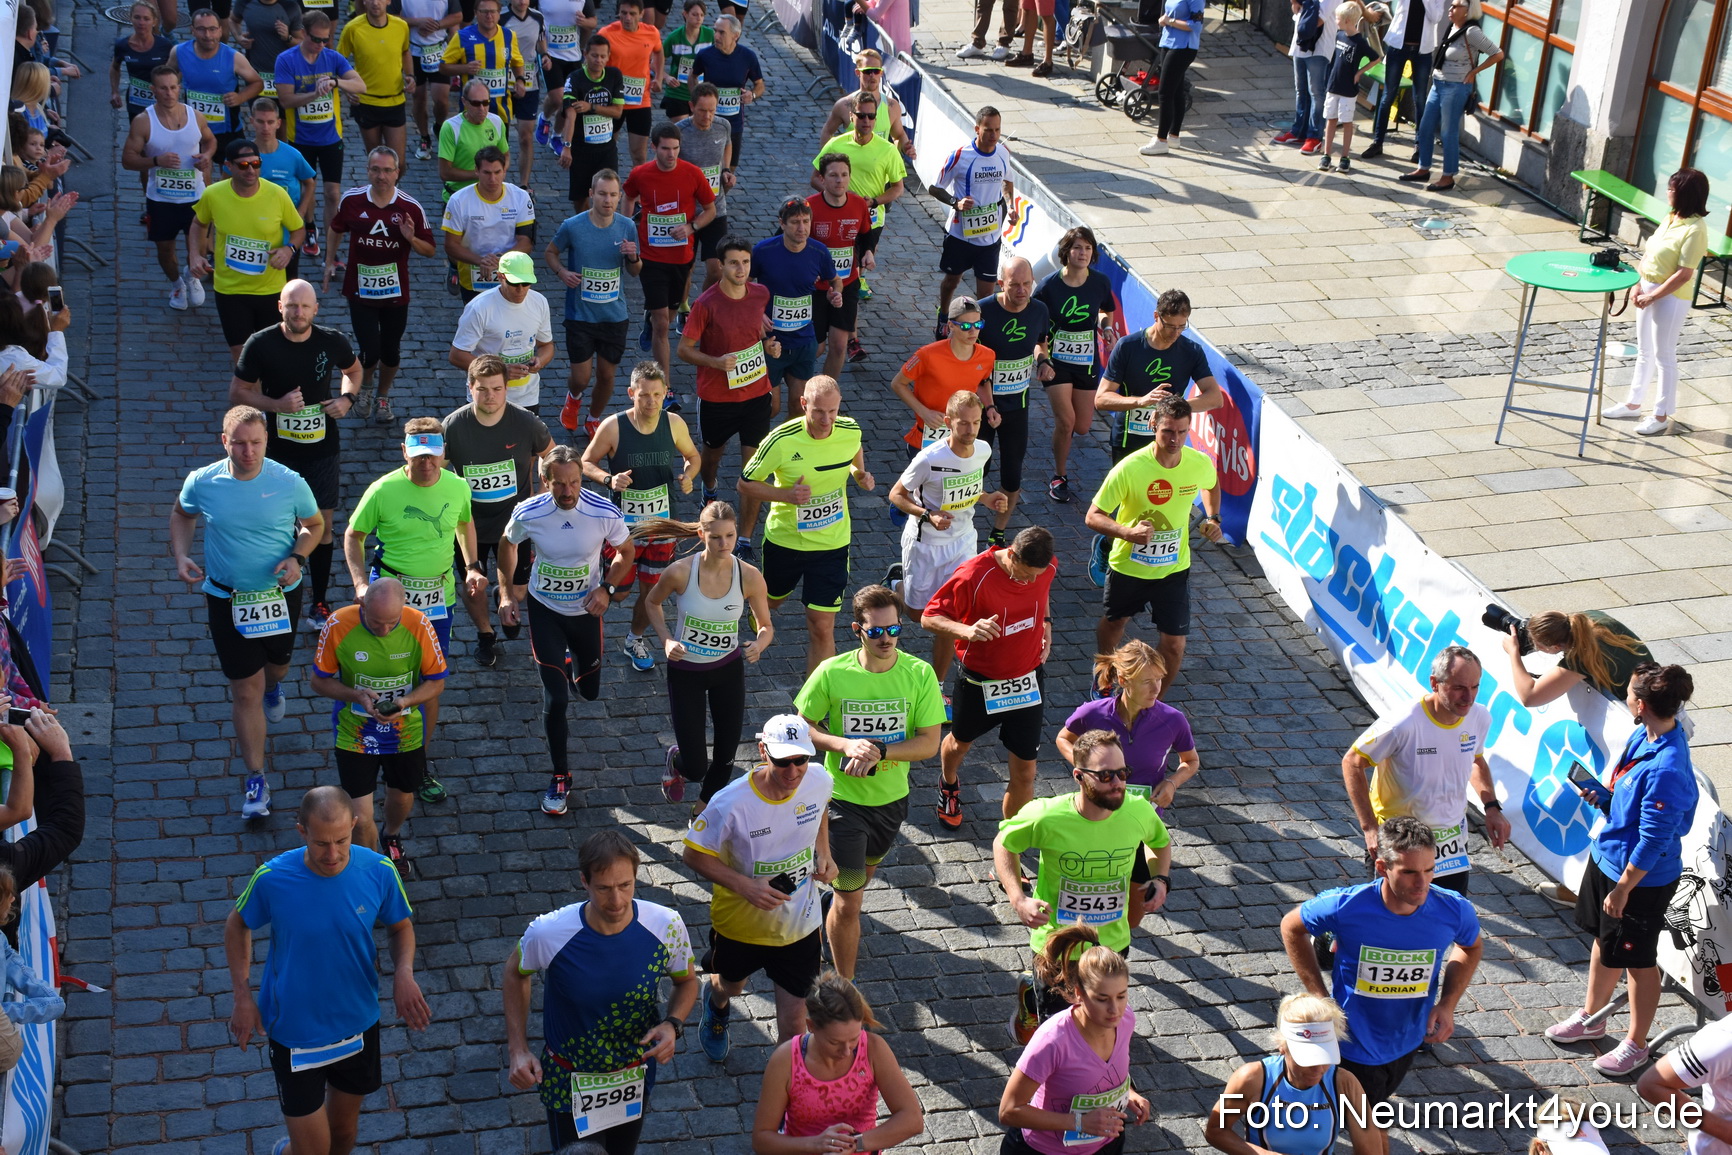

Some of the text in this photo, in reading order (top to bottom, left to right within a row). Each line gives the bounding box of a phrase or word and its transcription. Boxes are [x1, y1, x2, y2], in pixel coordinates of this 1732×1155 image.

[552, 34, 575, 43] 2222
[421, 53, 441, 64] 2525
[133, 87, 156, 99] 262
[624, 86, 642, 96] 700
[192, 101, 219, 115] 1374
[304, 102, 330, 113] 1349
[588, 122, 611, 135] 2051
[158, 168, 193, 178] BOCK
[974, 171, 1003, 180] ERDINGER
[160, 178, 192, 190] 2256
[651, 215, 683, 224] BOCK
[967, 214, 995, 228] 1130
[972, 226, 991, 235] DANIEL
[232, 238, 268, 251] BOCK
[358, 236, 400, 249] AREVA
[230, 247, 264, 265] 2831
[360, 266, 392, 276] BOCK
[585, 269, 617, 278] BOCK
[362, 276, 396, 288] 2786
[586, 280, 616, 292] 2597
[776, 298, 809, 308] BOCK
[777, 308, 808, 320] 2548
[1059, 331, 1090, 341] BOCK
[1058, 342, 1091, 354] 2437
[735, 356, 762, 377] 1090
[998, 359, 1030, 371] BOCK
[736, 371, 762, 384] FLORIAN
[999, 369, 1029, 384] 2441
[283, 417, 321, 431] 1229
[289, 431, 315, 440] SILVIO
[468, 461, 509, 476] BOCK
[471, 474, 511, 490] 2823
[947, 474, 981, 488] BOCK
[625, 488, 665, 499] BOCK
[949, 484, 979, 502] 1142
[628, 499, 664, 514] 2117
[803, 502, 839, 520] 2095
[950, 500, 975, 510] PHILIPP
[806, 516, 837, 528] MARKUS
[1136, 542, 1176, 555] 2116
[1135, 553, 1174, 563] MATTHIAS
[542, 565, 585, 577] BOCK
[402, 578, 442, 590] BOCK
[541, 577, 584, 592] 2297
[237, 590, 280, 604] BOCK
[546, 592, 580, 600] JOHANN
[239, 603, 283, 623] 2418
[245, 622, 280, 634] MARTIN
[690, 617, 735, 633] BOCK
[687, 628, 731, 649] 2299
[360, 675, 407, 689] BOCK
[990, 676, 1032, 697] 2559
[995, 695, 1032, 707] THOMAS
[848, 702, 900, 713] BOCK
[850, 716, 899, 732] 2542
[795, 805, 806, 815] 20
[762, 850, 808, 874] BOCK
[1065, 881, 1121, 894] BOCK
[1065, 895, 1118, 911] 2543
[1366, 950, 1429, 963] BOCK
[1367, 966, 1425, 982] 1348
[1368, 985, 1417, 993] FLORIAN
[578, 1067, 640, 1088] BOCK
[581, 1085, 636, 1113] 2598
